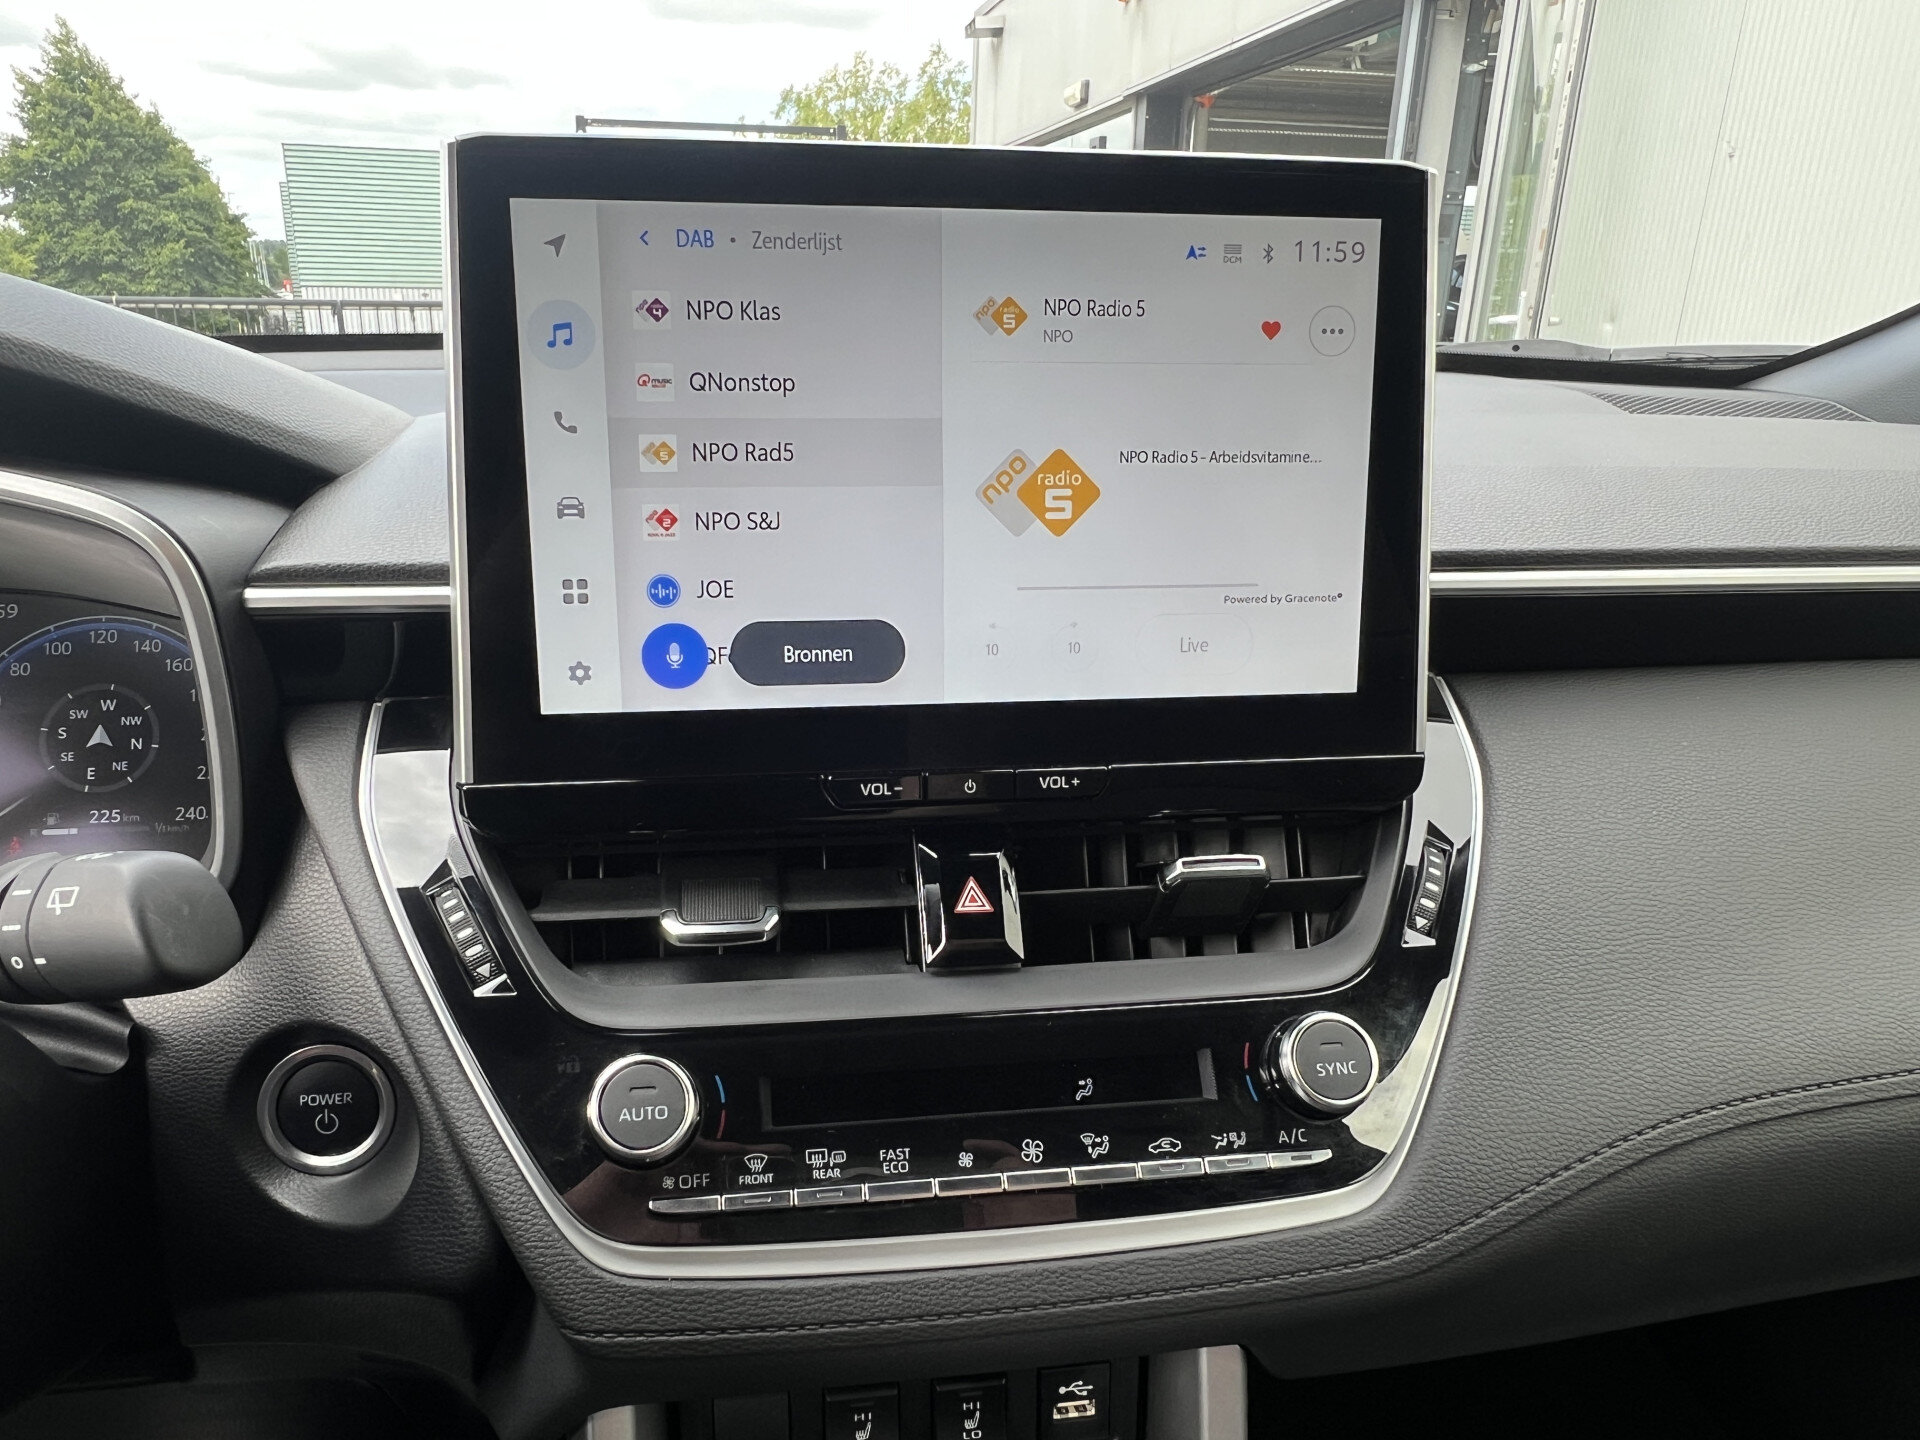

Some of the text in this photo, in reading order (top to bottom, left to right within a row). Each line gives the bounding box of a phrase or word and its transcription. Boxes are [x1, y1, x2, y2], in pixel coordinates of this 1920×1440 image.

[676, 229, 843, 255] DAB Zenderlijst
[1295, 240, 1365, 263] 11:59
[1223, 255, 1242, 263] DCM
[687, 300, 781, 321] NPO Klas
[1043, 299, 1146, 317] NPO Radio 5
[1003, 313, 1016, 328] 5
[1043, 330, 1073, 343] NPO
[689, 372, 795, 397] QNonstop
[692, 443, 794, 462] NPO Rad5
[1119, 450, 1148, 463] NPO
[1151, 450, 1188, 463] Radio
[1191, 451, 1198, 463] 5
[982, 456, 1027, 505] npo
[1038, 470, 1082, 485] radio
[1044, 489, 1073, 519] 5
[695, 512, 780, 531] NPO S&J
[697, 580, 734, 599] JOE
[1224, 594, 1267, 604] Powered
[1270, 594, 1282, 605] by
[90, 630, 118, 644] 120
[44, 641, 72, 656] 100
[133, 639, 162, 653] 140
[985, 643, 999, 656] 10
[1068, 641, 1081, 654] 10
[1180, 636, 1209, 654] Live
[784, 645, 853, 663] Bronnen
[10, 662, 31, 676] 80
[165, 658, 193, 672] 160
[100, 699, 117, 711] W
[69, 709, 89, 719] SW
[121, 716, 143, 726] NW
[58, 728, 67, 739] S
[131, 738, 143, 750] N
[60, 752, 74, 762] SE
[112, 761, 128, 771] NE
[87, 768, 95, 780] E
[89, 810, 121, 824] 225
[175, 806, 206, 821] 240
[1316, 1060, 1357, 1077] SYNC
[300, 1092, 353, 1106] POWER
[619, 1105, 668, 1122] AUTO
[1279, 1128, 1308, 1144] A/C
[880, 1148, 911, 1162] FAST
[812, 1167, 841, 1179] REAR
[884, 1160, 909, 1174] ECO
[679, 1173, 711, 1189] OFF
[739, 1173, 774, 1186] FRONT
[963, 1401, 979, 1411] HI
[855, 1412, 871, 1422] HI
[963, 1429, 982, 1440] LO
